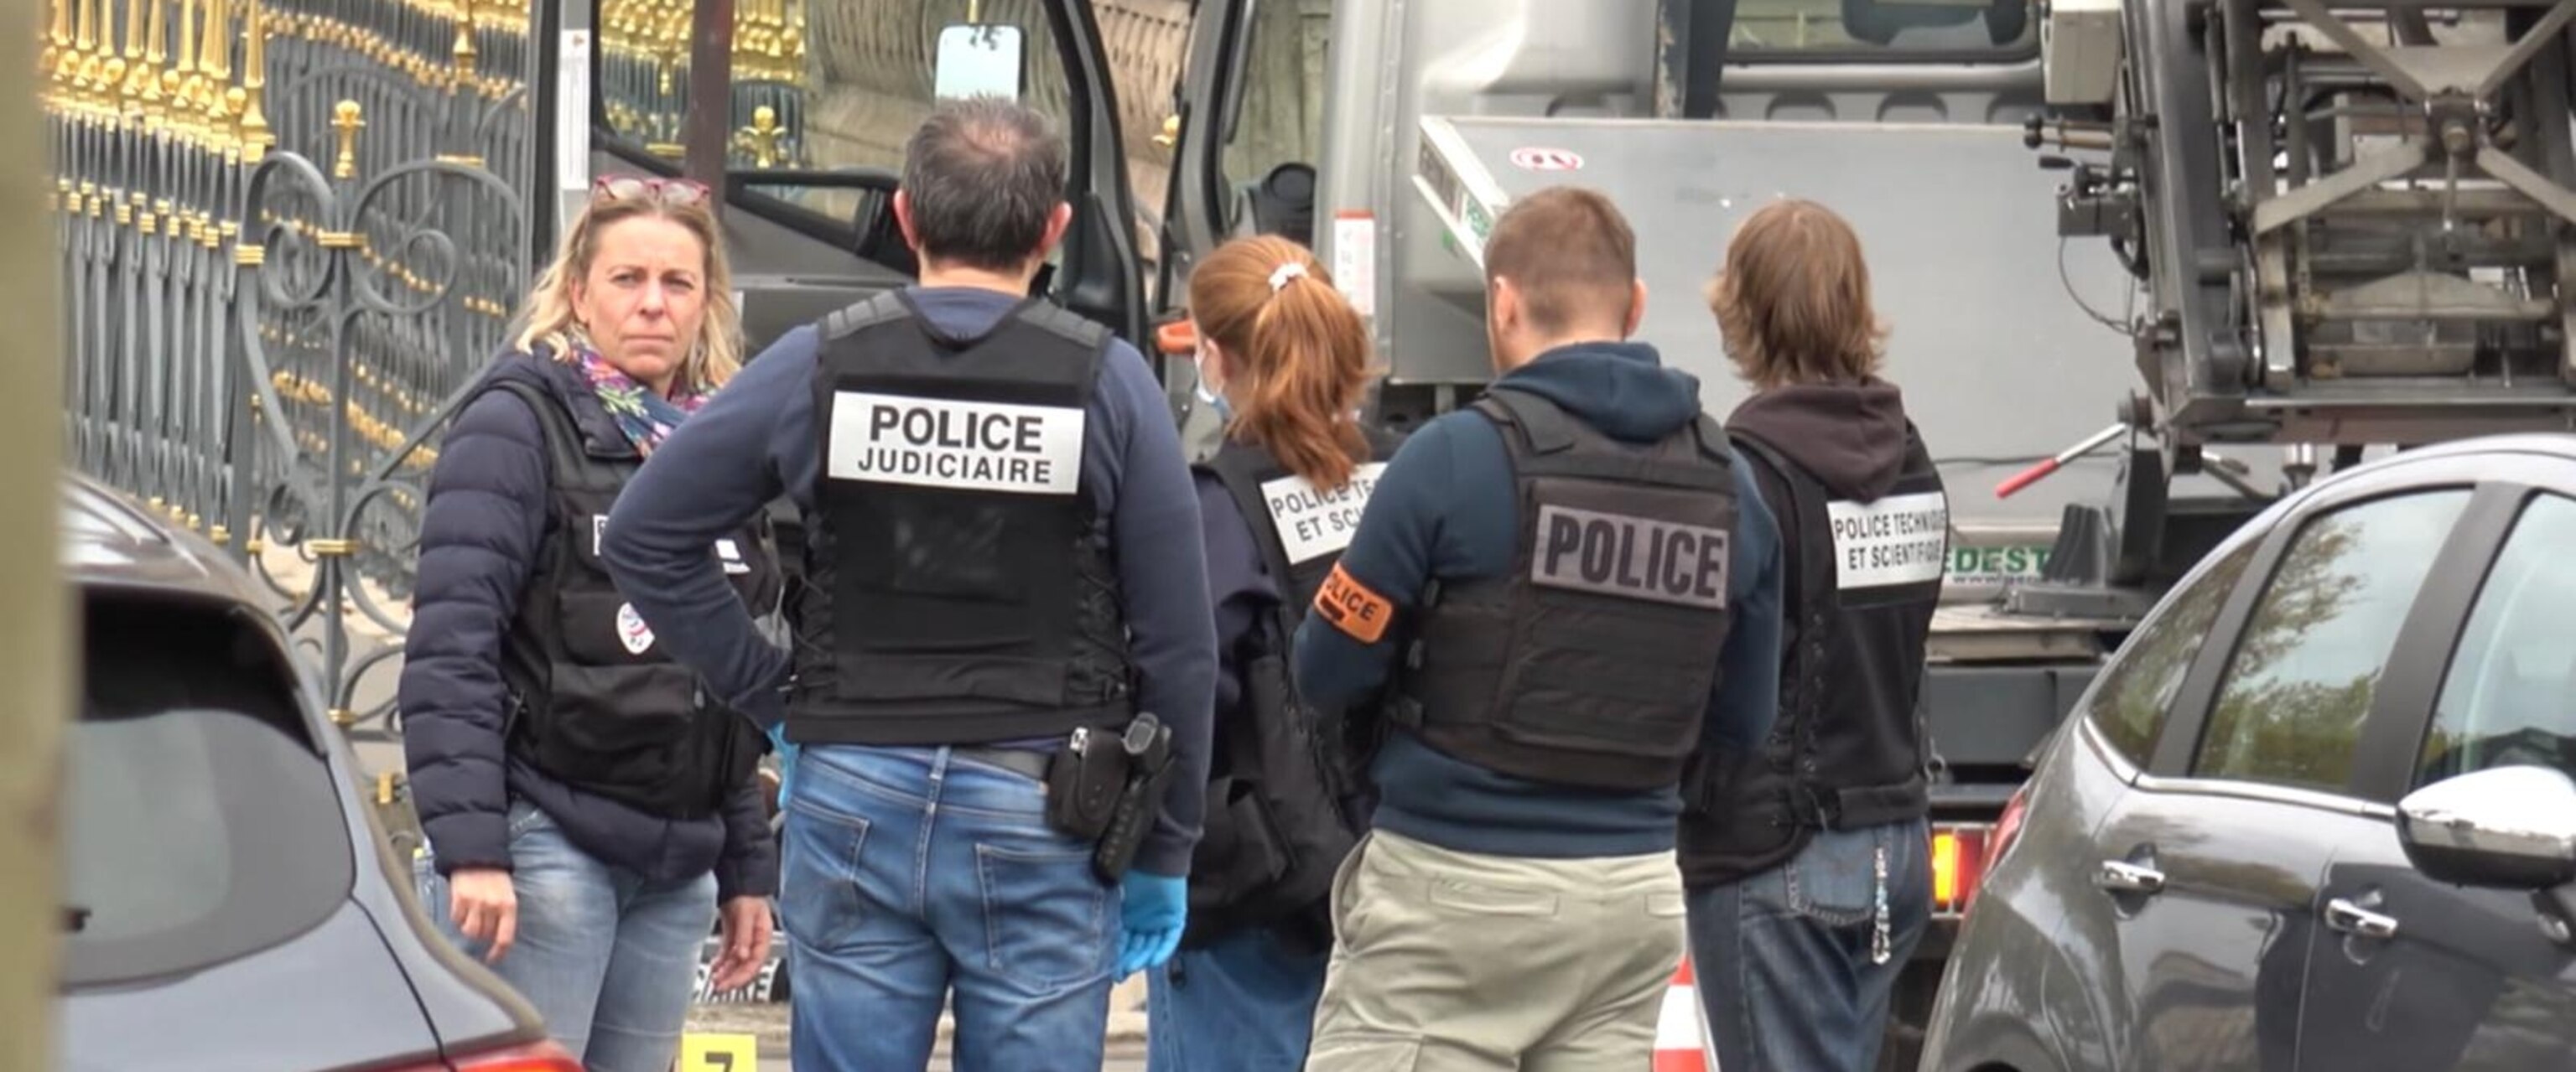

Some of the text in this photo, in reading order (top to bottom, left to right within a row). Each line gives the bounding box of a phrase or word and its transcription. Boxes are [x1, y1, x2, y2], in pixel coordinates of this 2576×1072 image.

[870, 404, 1043, 453] POLICE
[857, 448, 1052, 484] JUDICIAIRE
[1296, 516, 1322, 541] ET
[1835, 514, 1890, 540] POLICE
[1545, 514, 1723, 598] POLICE
[1848, 547, 1866, 569] ET
